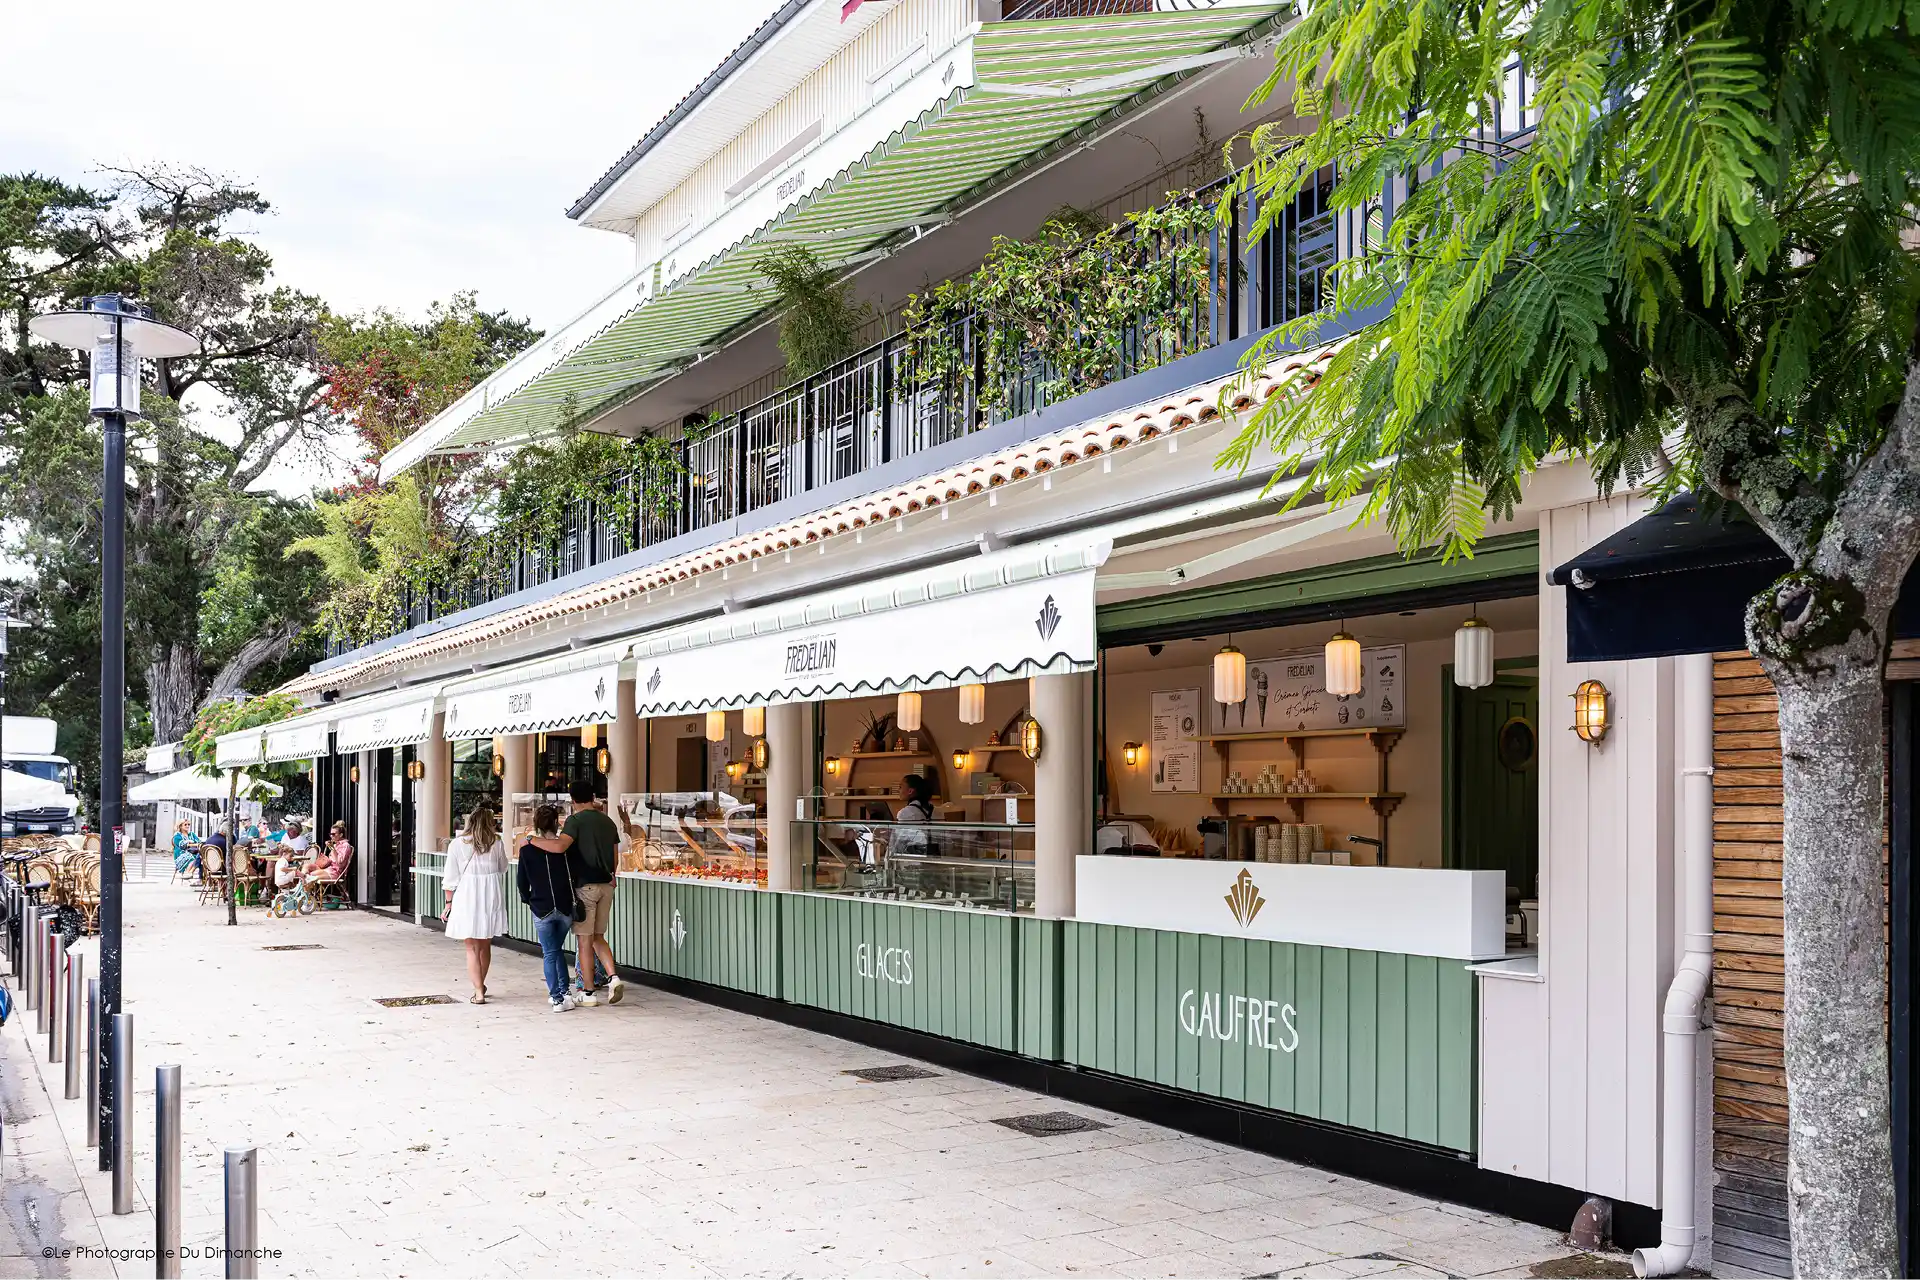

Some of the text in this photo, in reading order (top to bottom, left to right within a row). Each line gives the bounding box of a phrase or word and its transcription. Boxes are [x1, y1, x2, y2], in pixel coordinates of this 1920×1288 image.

[1295, 700, 1320, 716] Sorbets
[857, 944, 912, 985] GLACES
[1180, 989, 1299, 1053] GAUFRES
